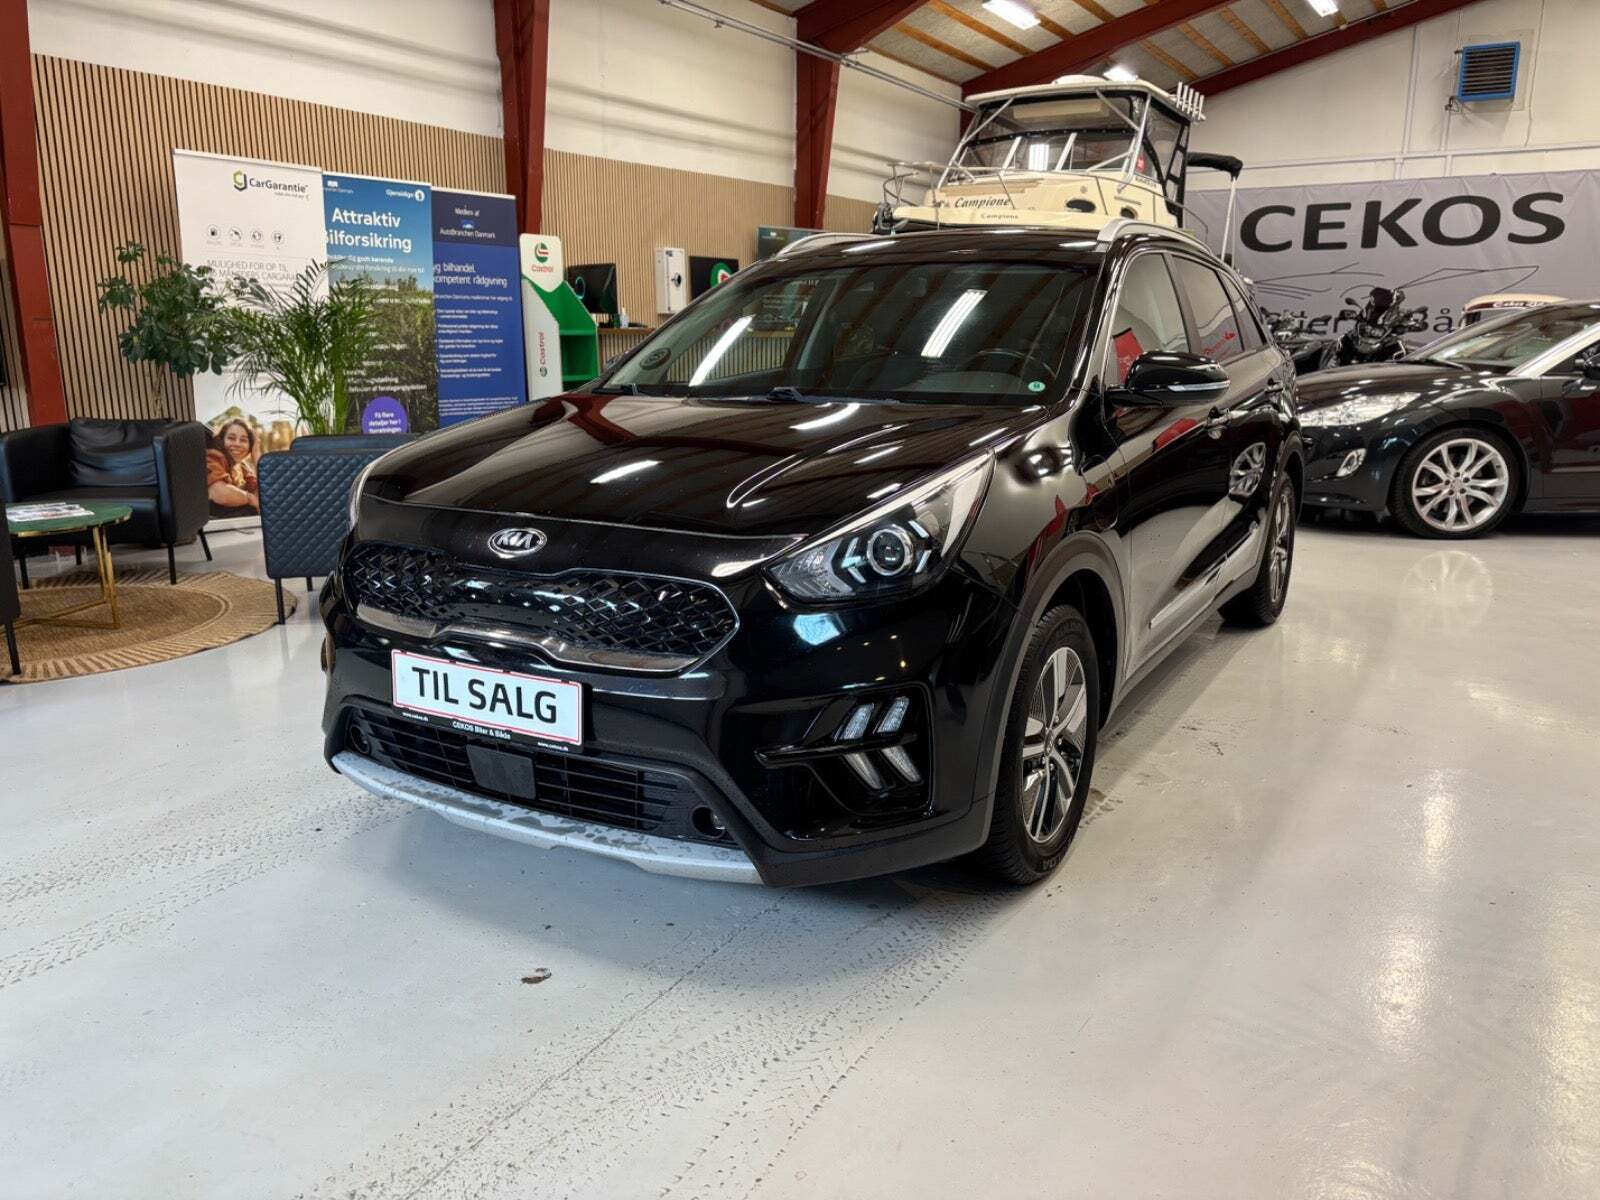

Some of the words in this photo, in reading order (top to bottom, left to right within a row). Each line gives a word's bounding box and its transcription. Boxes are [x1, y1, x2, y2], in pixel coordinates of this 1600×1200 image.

[249, 178, 306, 193] CarGarantie
[954, 196, 1009, 209] Campione
[332, 207, 401, 228] Attraktiv
[1239, 191, 1566, 253] CEKOS
[248, 261, 265, 271] FOR
[265, 262, 277, 272] OP
[531, 264, 554, 274] Castrol
[433, 274, 472, 286] ompetent
[538, 331, 547, 365] Castrol
[497, 533, 533, 549] KIA
[411, 666, 459, 705] TIL
[467, 678, 557, 724] SALG
